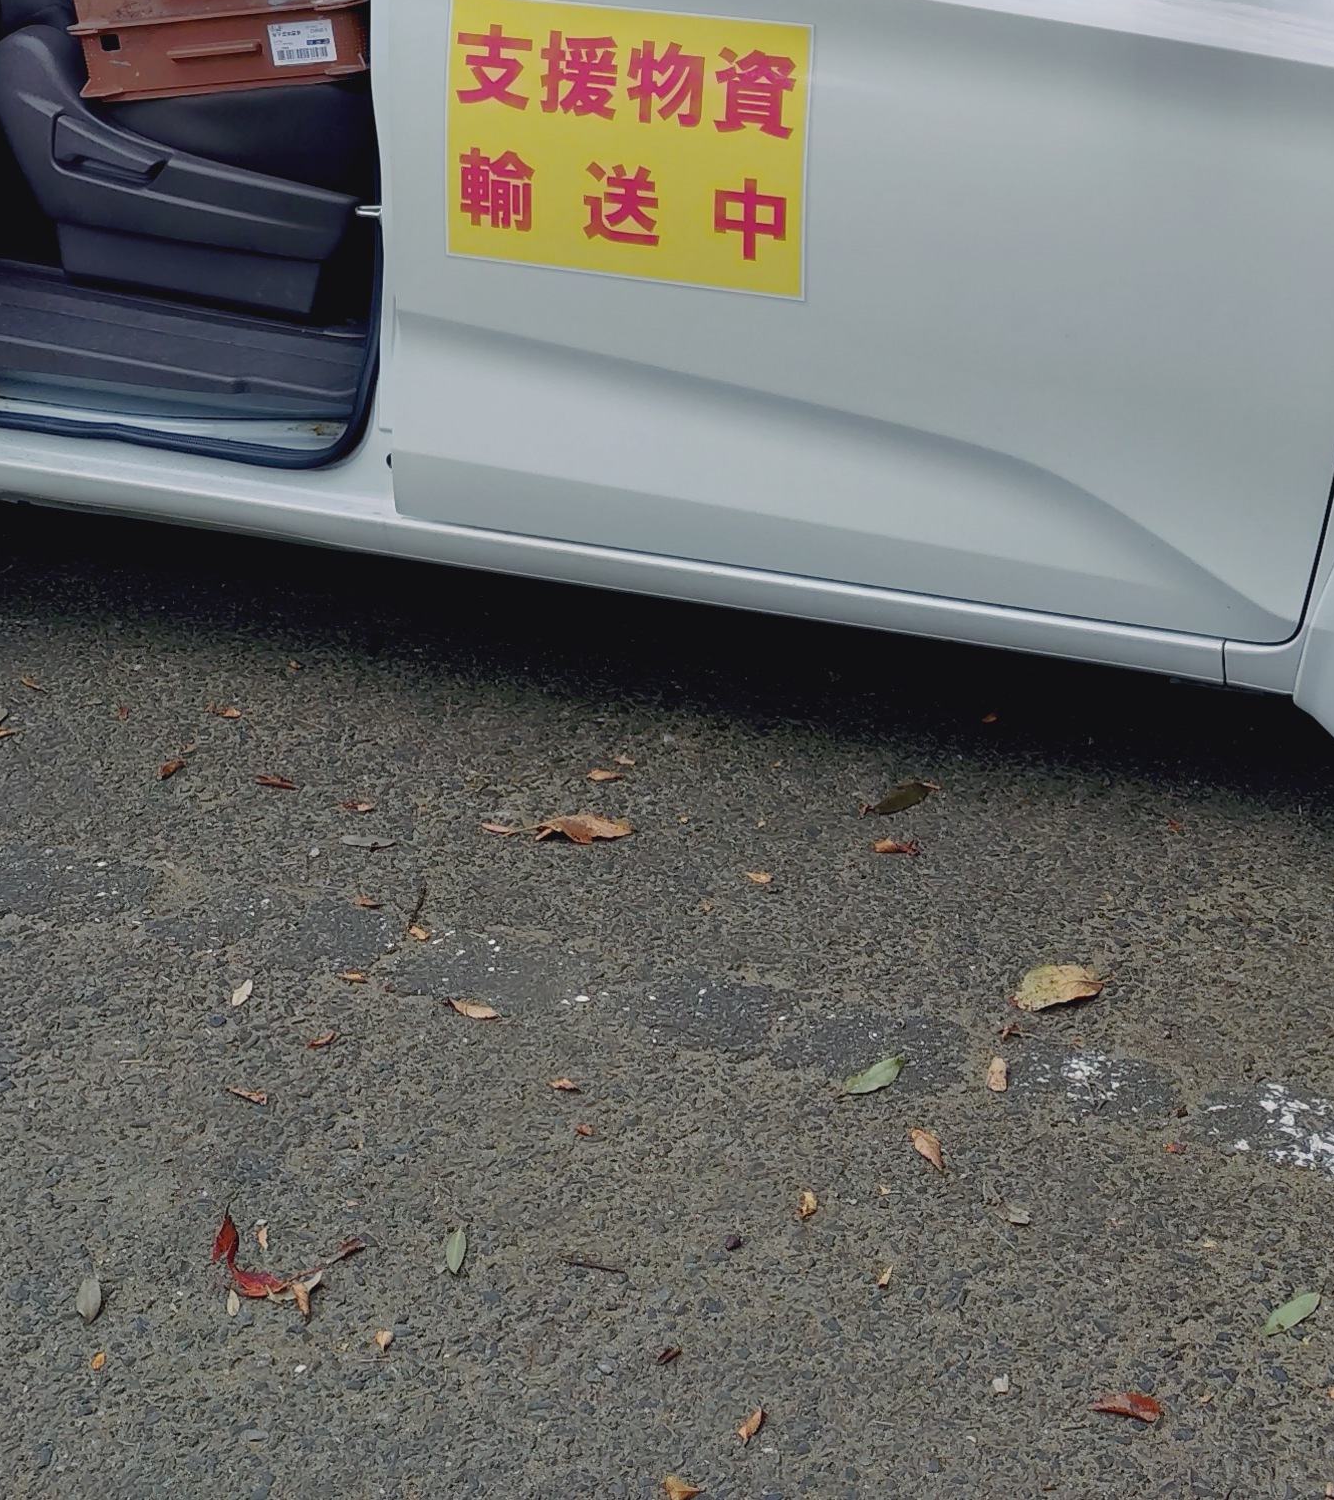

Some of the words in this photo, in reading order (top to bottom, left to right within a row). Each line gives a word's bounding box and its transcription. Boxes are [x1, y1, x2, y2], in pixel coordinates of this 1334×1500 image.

[456, 23, 797, 140] 支援物資
[458, 146, 788, 261] 輸送中
